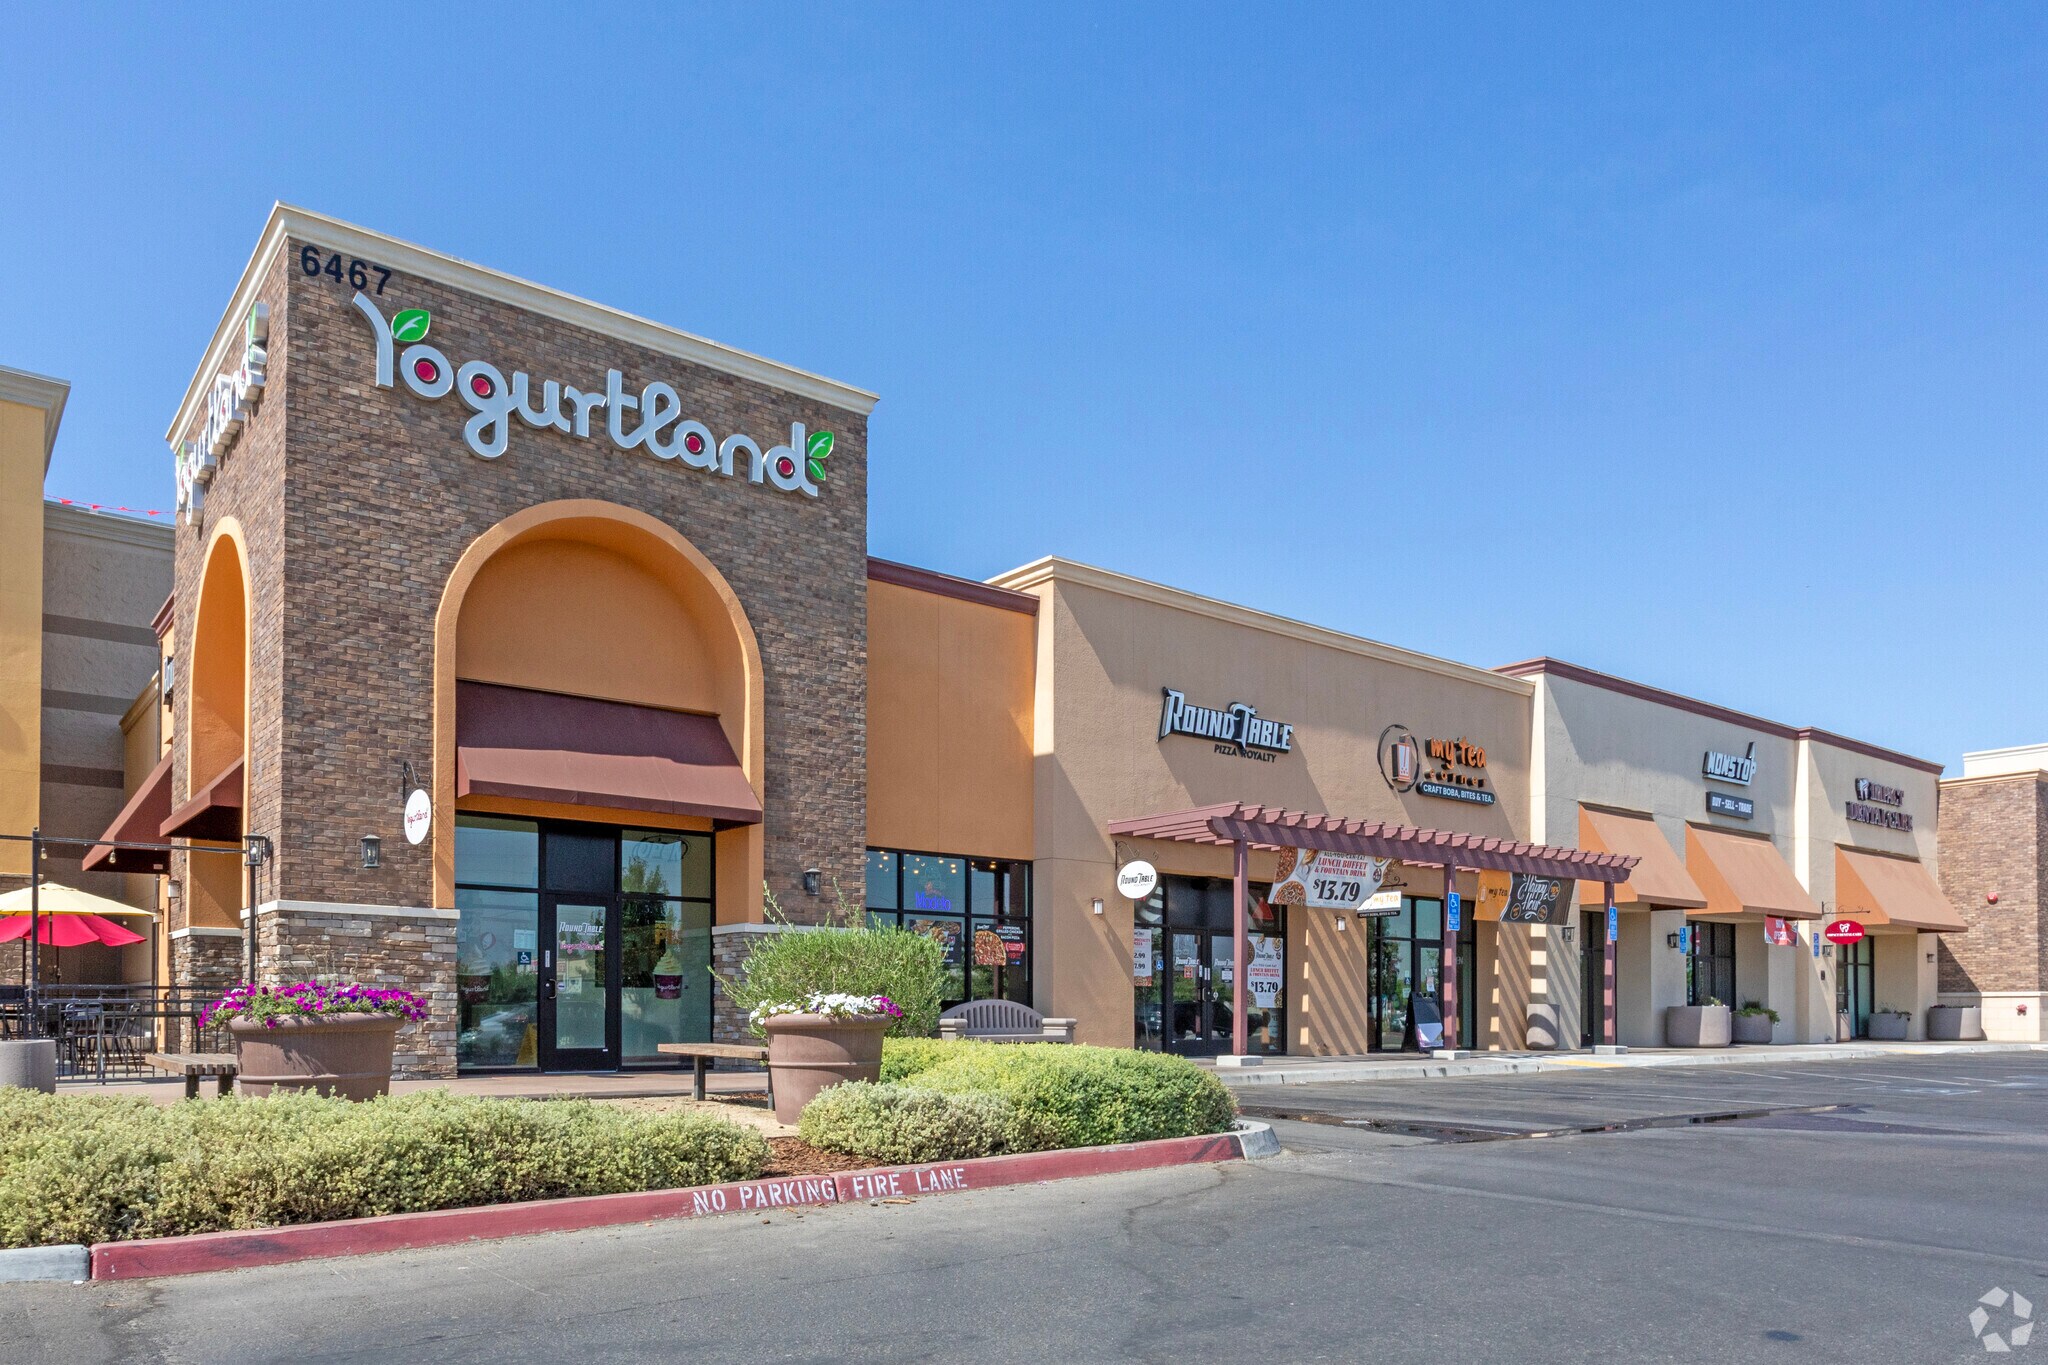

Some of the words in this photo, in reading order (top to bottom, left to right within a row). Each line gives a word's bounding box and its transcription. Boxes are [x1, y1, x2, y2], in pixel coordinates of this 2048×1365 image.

[300, 245, 392, 296] 6467
[352, 290, 820, 498] Yogurtland
[1162, 687, 1238, 740] ROUND
[1232, 702, 1293, 751] TABLE
[1213, 744, 1238, 757] PIZZA
[1240, 749, 1277, 763] ROYALTY
[1427, 737, 1455, 770] my
[1459, 735, 1487, 768] tea
[1706, 742, 1757, 782] NONSTOP
[1422, 784, 1442, 796] CRAFT
[1442, 786, 1461, 799] BOBA,
[1460, 790, 1476, 800] BITES
[1476, 792, 1482, 801] &
[1724, 799, 1735, 811] SELL
[1738, 802, 1753, 814] TRADE
[1314, 866, 1319, 874] &
[1320, 867, 1349, 876] FOUNTAIN
[1349, 869, 1367, 877] DRINK
[1317, 857, 1342, 867] LUNCH
[1341, 858, 1368, 870] BUFFET
[1120, 874, 1139, 886] ROUND
[1137, 872, 1154, 884] TABLE
[1517, 873, 1550, 902] Happy
[1312, 878, 1361, 902] $13.79
[914, 890, 952, 911] Modelo
[1521, 894, 1541, 911] Hour
[559, 921, 583, 933] ROUND
[581, 922, 604, 933] TABLE
[1250, 980, 1279, 993] $13.79
[692, 1189, 726, 1216] NO
[739, 1178, 836, 1209] PARKING
[853, 1173, 903, 1199] FIRE
[915, 1167, 968, 1193] LANE
